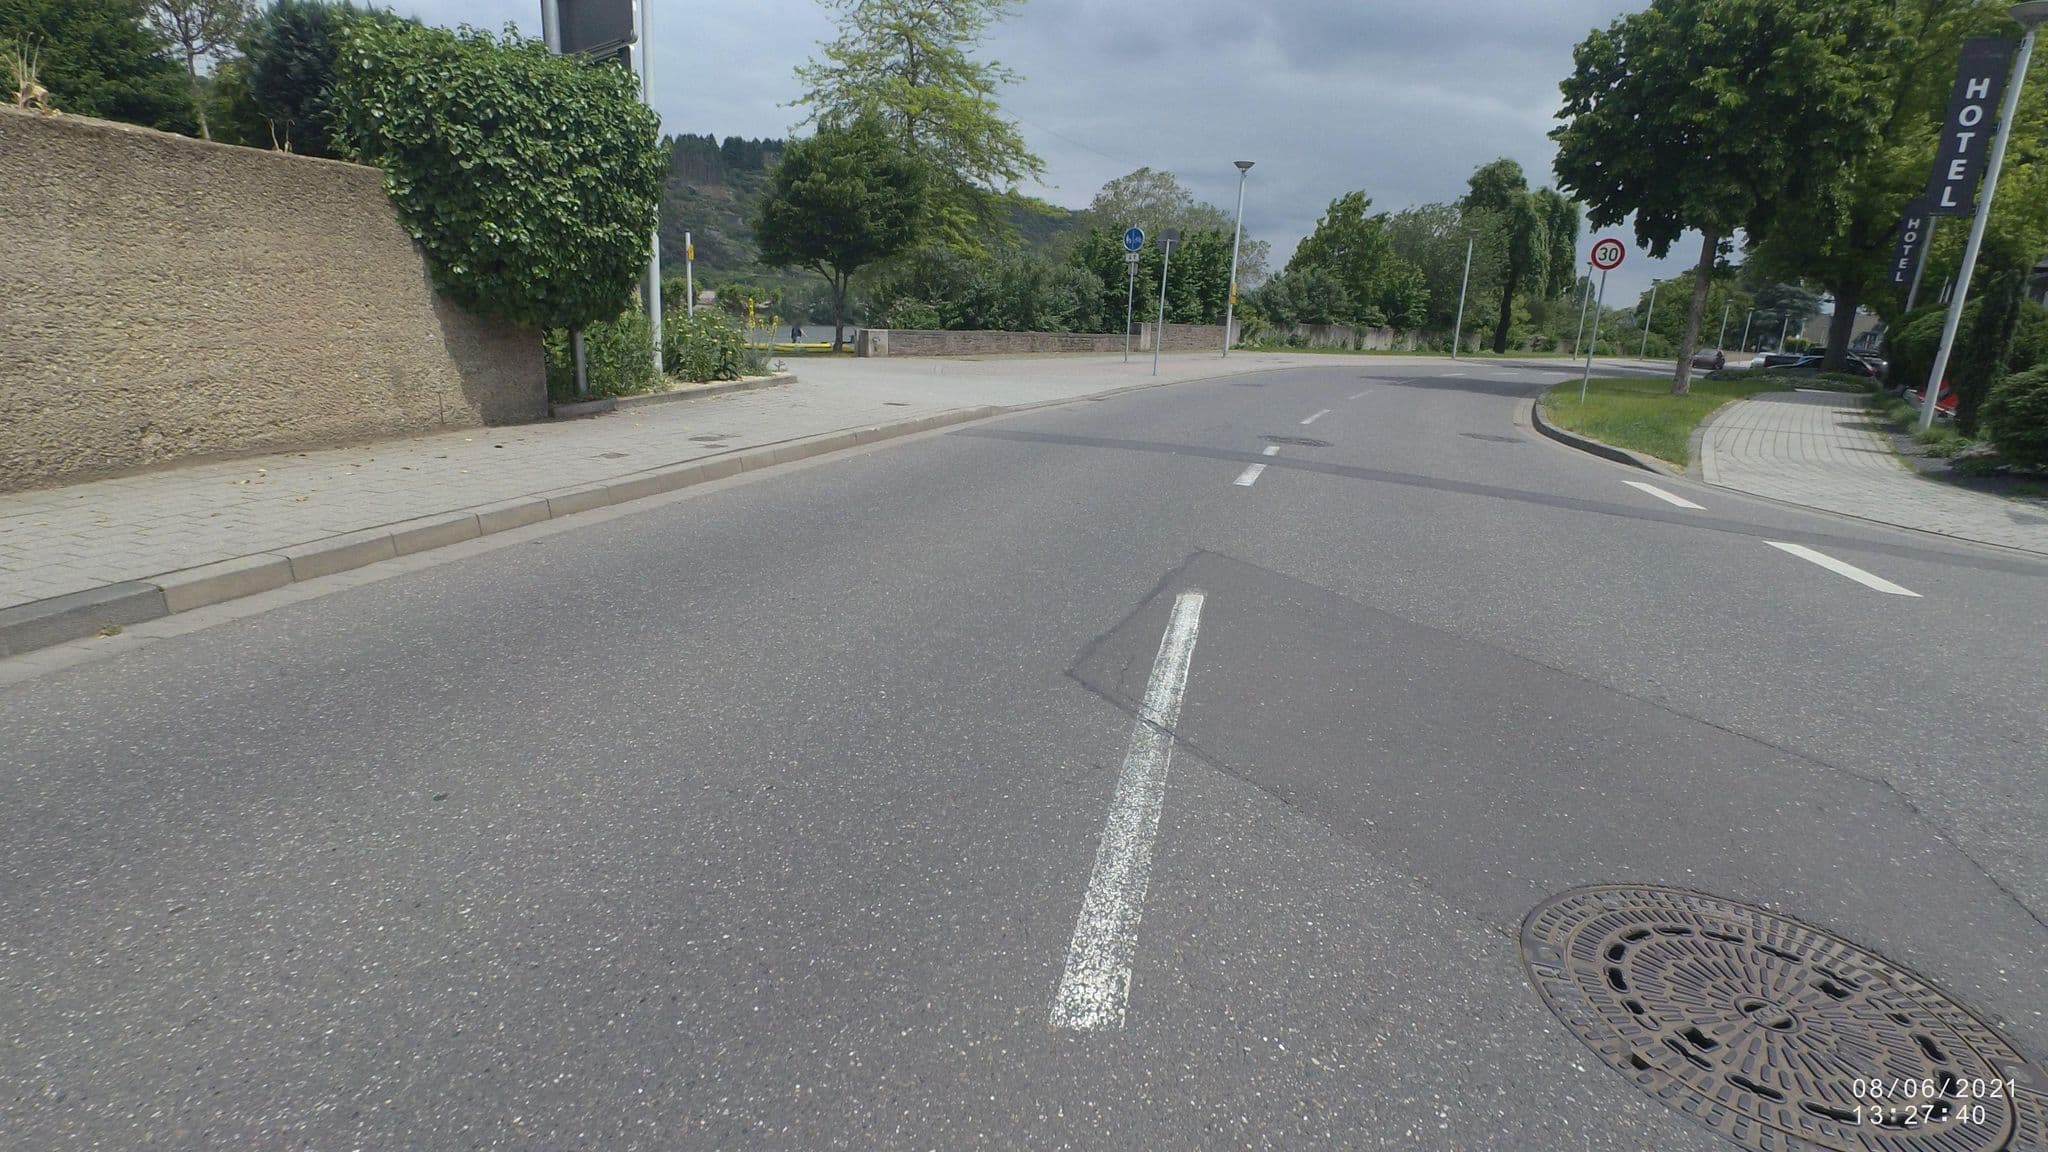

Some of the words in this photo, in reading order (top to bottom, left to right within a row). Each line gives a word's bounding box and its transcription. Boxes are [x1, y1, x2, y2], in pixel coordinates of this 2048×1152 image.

[1940, 77, 1990, 207] HOTEL
[1598, 247, 1619, 262] 30
[1895, 218, 1921, 282] HOTEL
